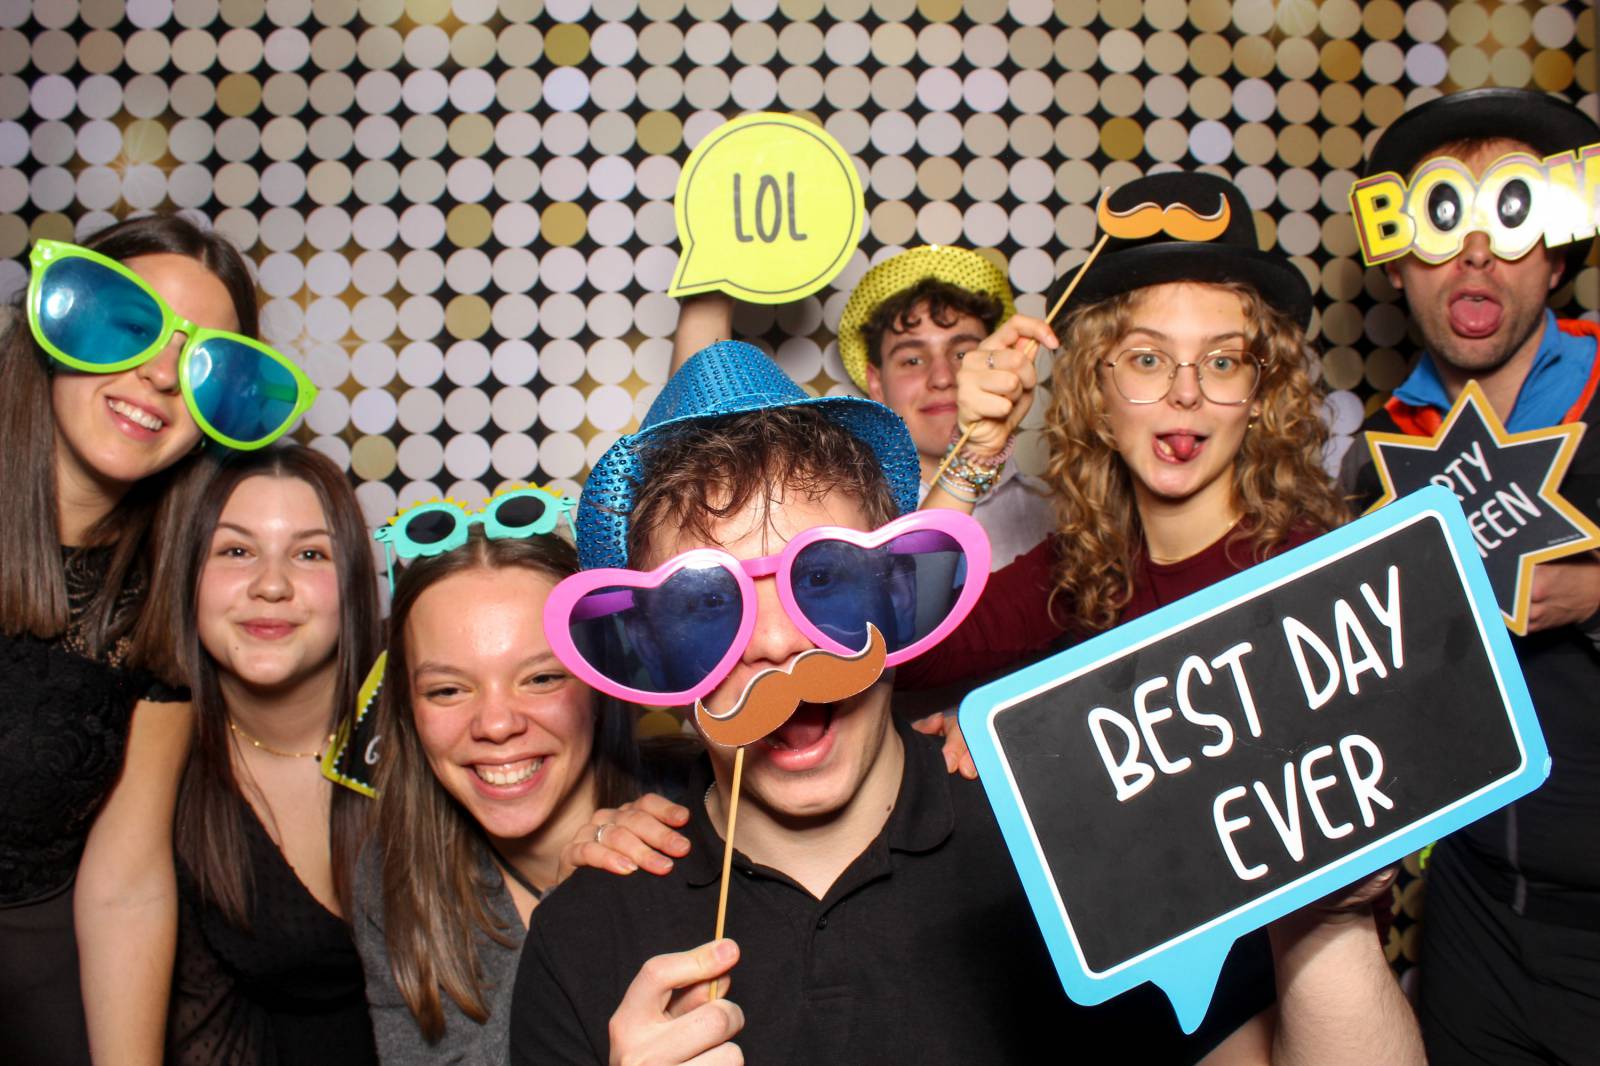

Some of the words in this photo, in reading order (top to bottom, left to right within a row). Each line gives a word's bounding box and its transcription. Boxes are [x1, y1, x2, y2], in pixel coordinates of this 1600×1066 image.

[733, 171, 808, 243] LOL
[1467, 481, 1542, 558] EEN
[1087, 641, 1262, 802] BEST
[1282, 564, 1404, 711] DAY
[1212, 734, 1395, 881] EVER
